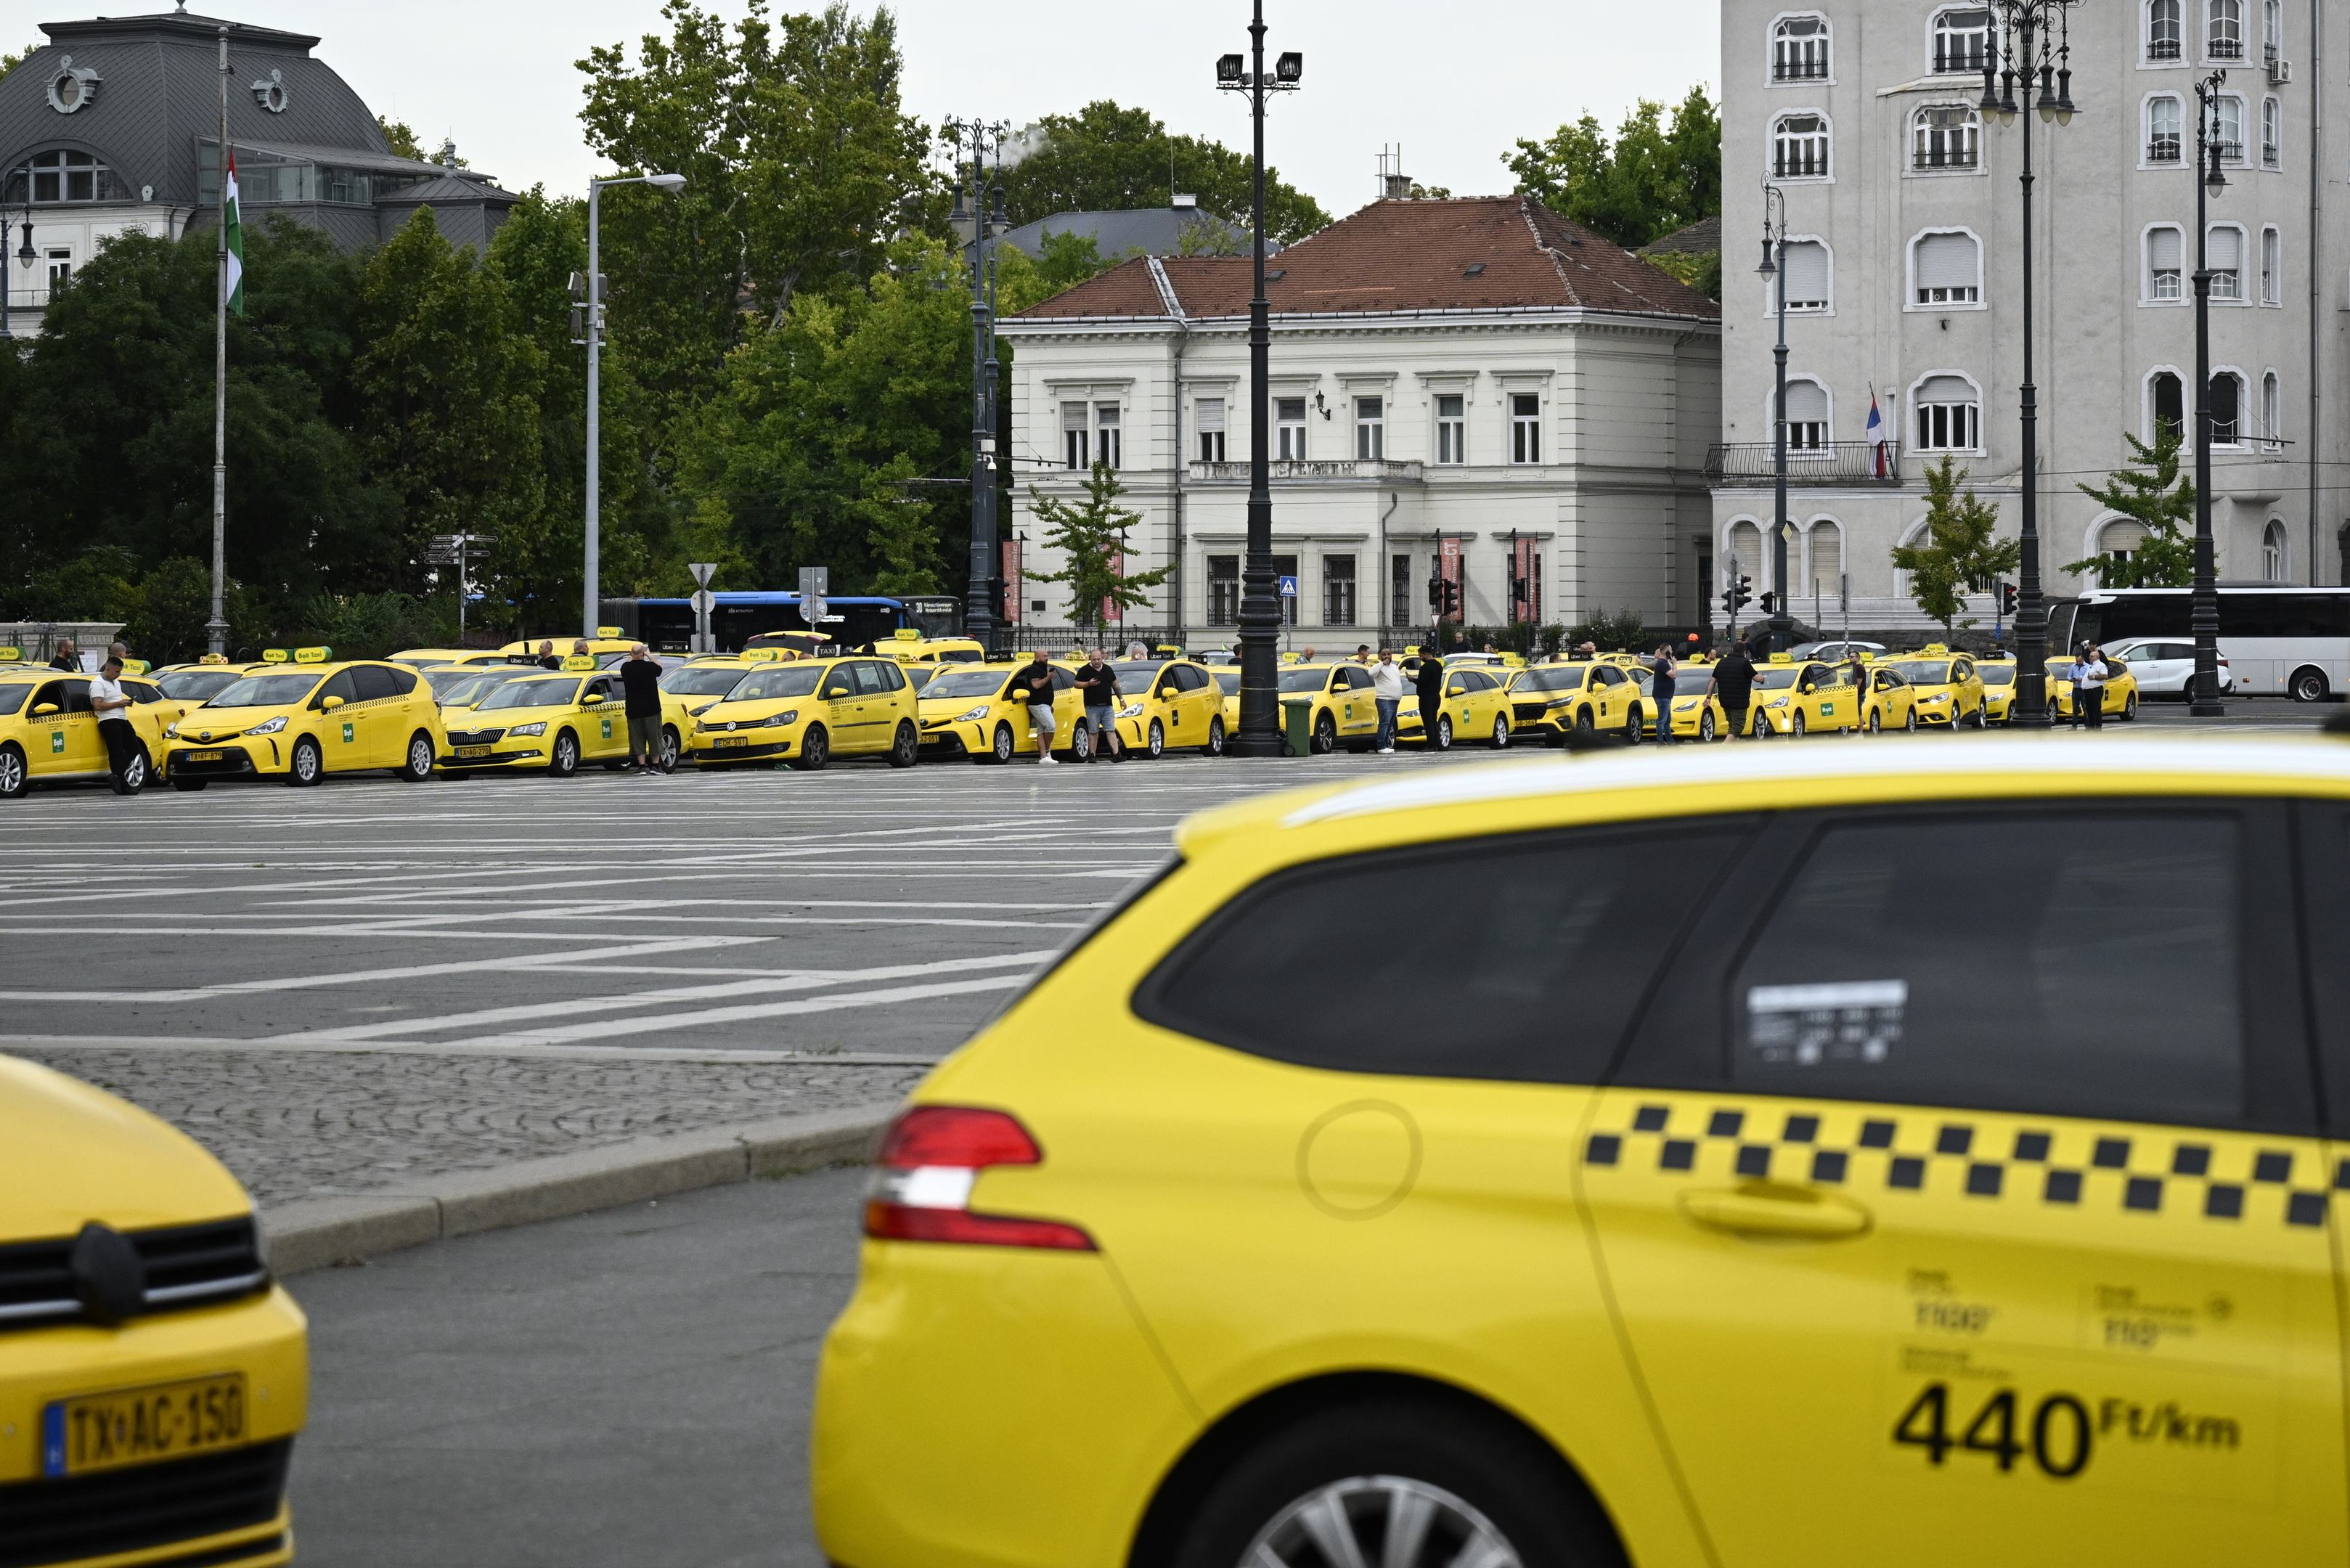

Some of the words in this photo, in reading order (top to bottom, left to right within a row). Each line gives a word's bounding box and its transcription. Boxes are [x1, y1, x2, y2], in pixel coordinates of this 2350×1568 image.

[1444, 542, 1457, 555] CT
[916, 602, 923, 613] 30
[53, 738, 63, 747] Bolt
[1893, 1381, 2092, 1479] 440
[2100, 1397, 2240, 1450] Ft/km
